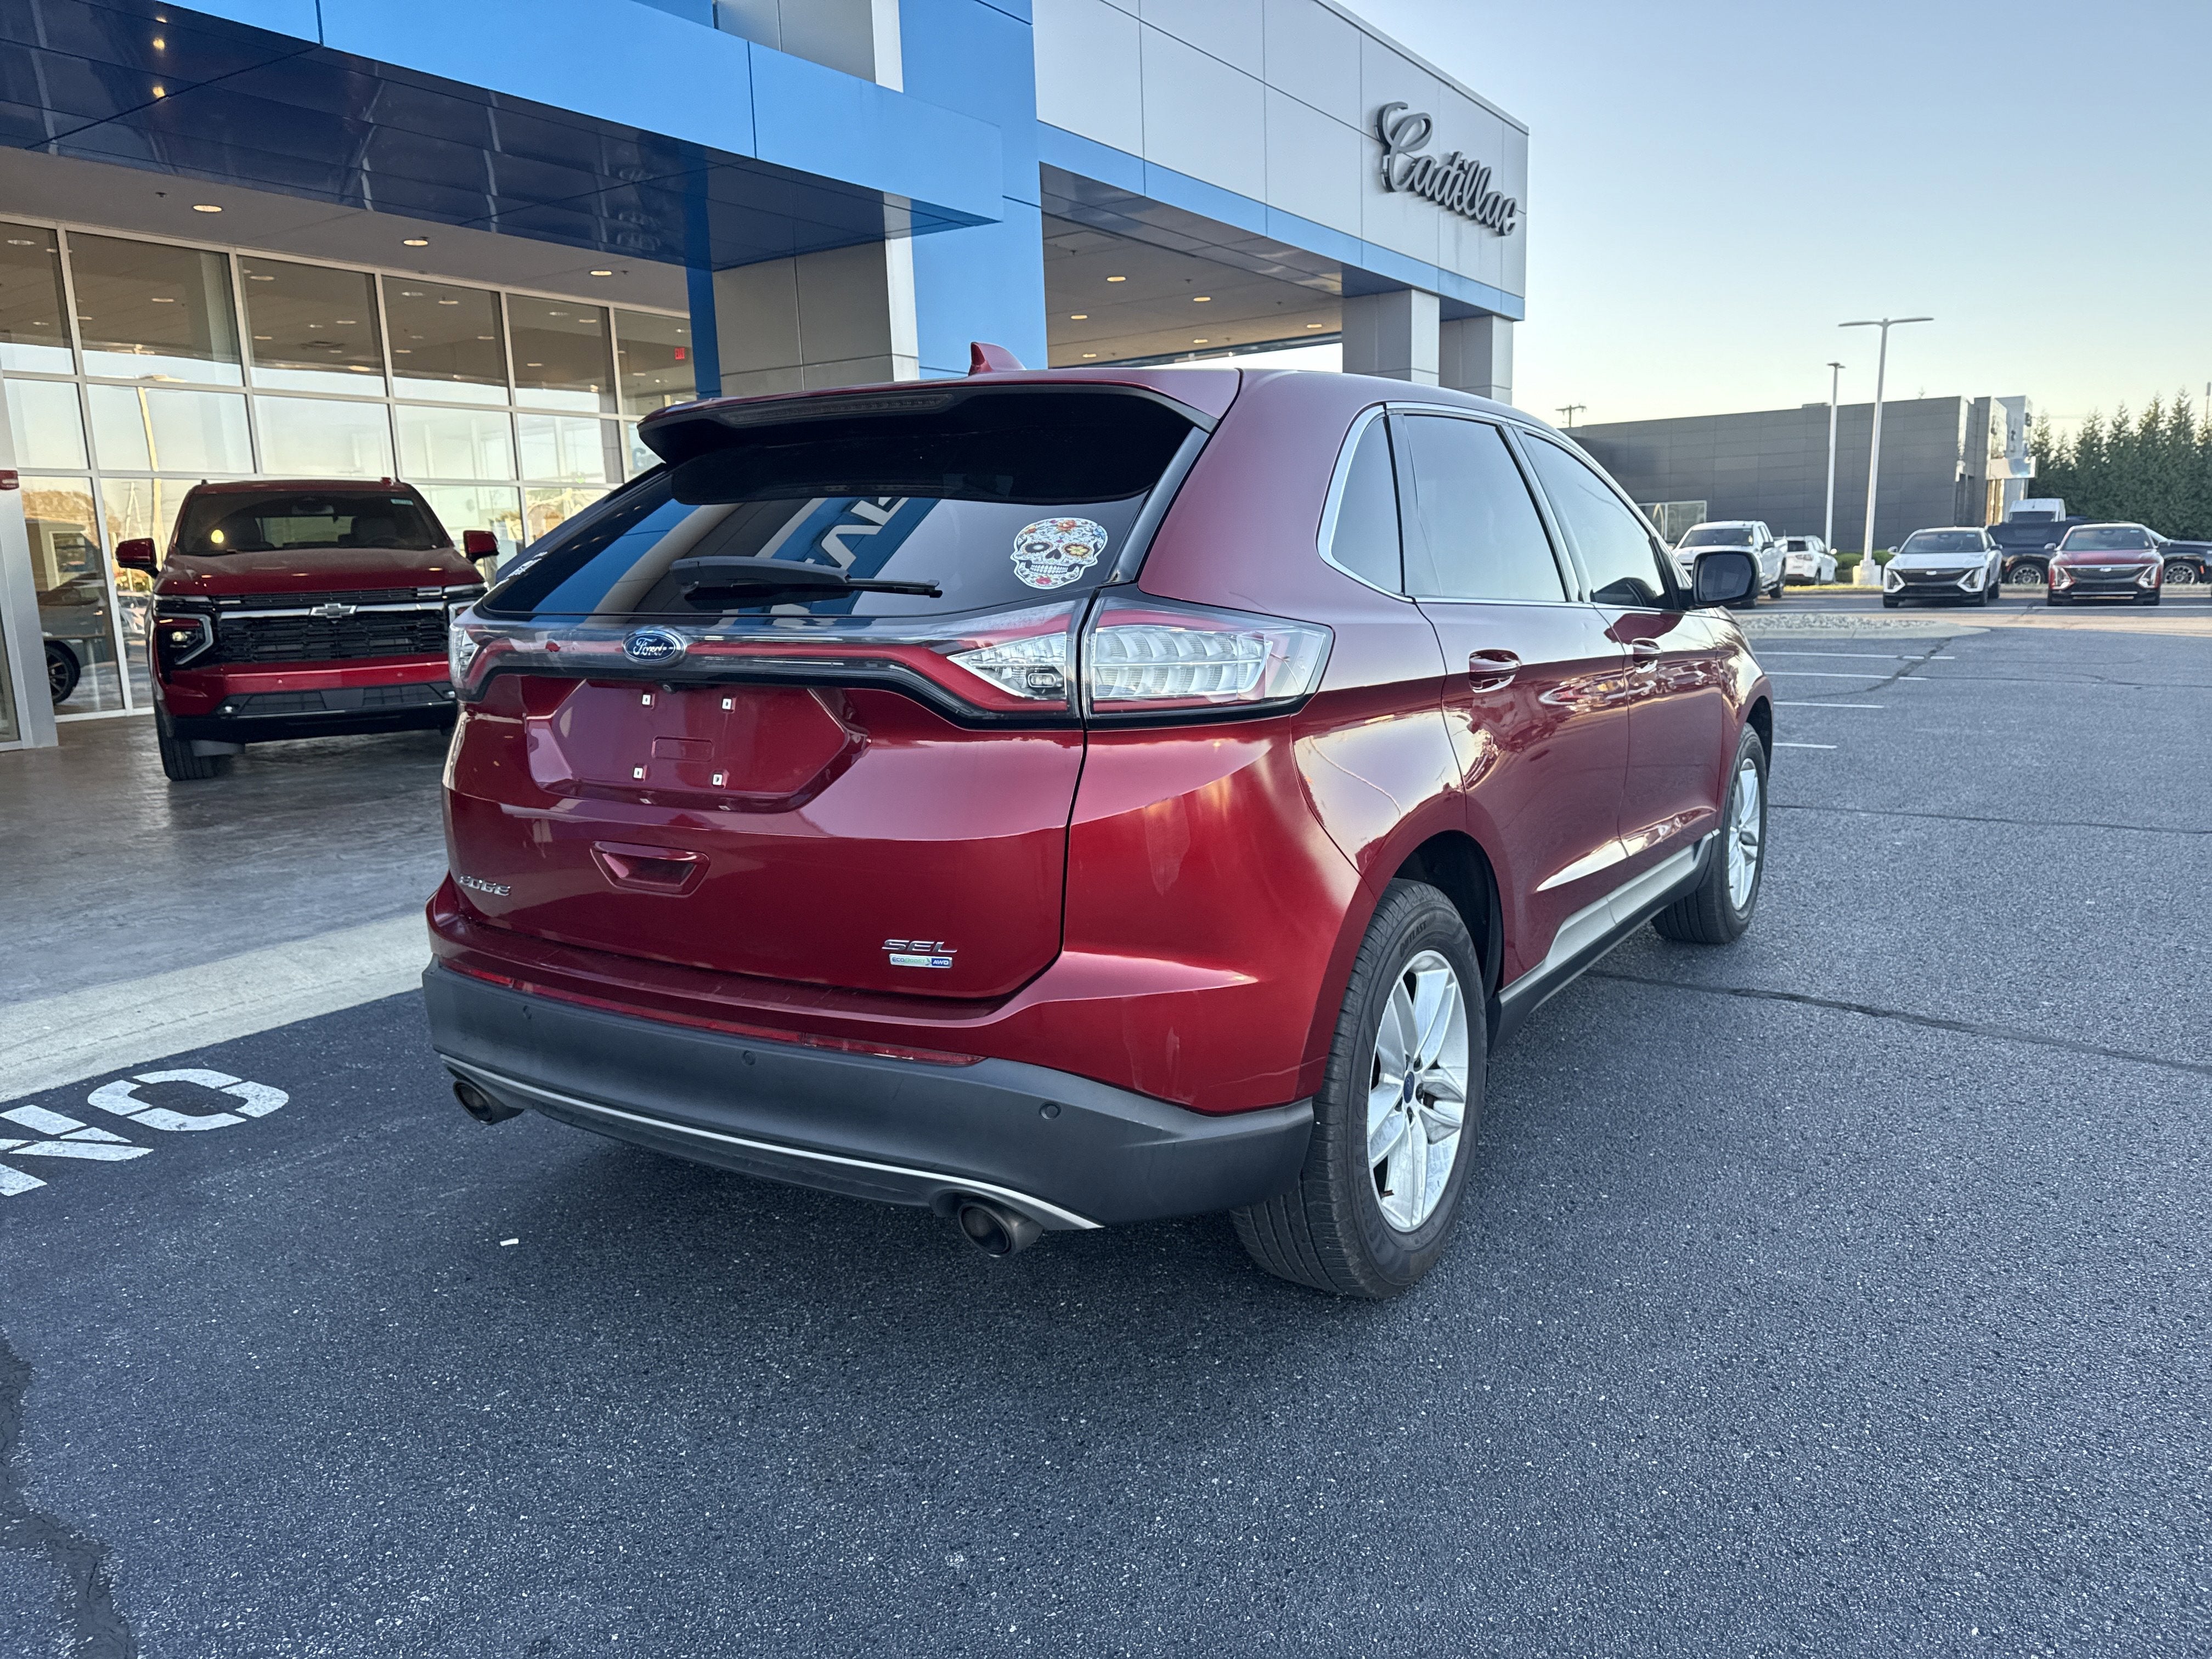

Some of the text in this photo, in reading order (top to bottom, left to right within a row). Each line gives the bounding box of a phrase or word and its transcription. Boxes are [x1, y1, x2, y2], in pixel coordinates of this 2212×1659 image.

[1375, 101, 1516, 236] Cadillac
[633, 637, 667, 656] Ford
[881, 939, 958, 953] SEL
[0, 1069, 289, 1197] NO
